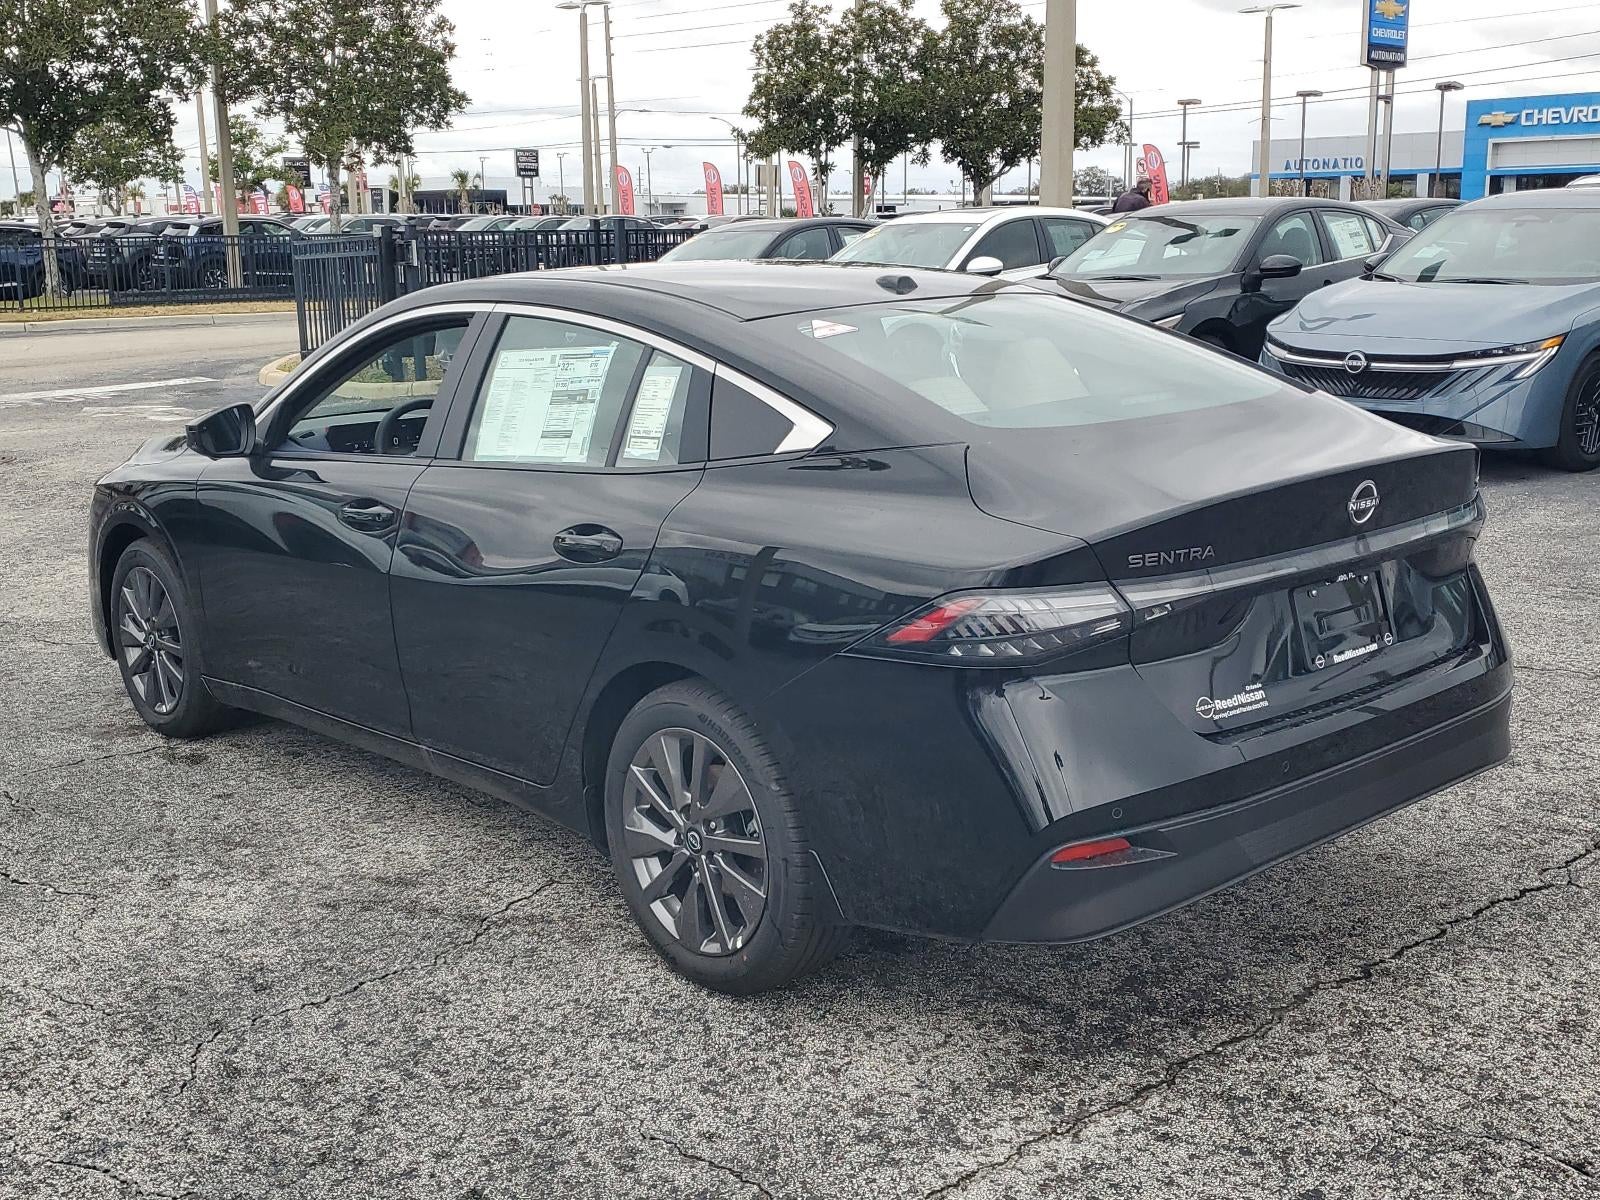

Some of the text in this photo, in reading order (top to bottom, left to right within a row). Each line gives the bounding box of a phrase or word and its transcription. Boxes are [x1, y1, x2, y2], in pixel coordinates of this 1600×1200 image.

[1372, 27, 1406, 40] CHEVROLET
[1371, 49, 1405, 62] AUTONATION
[1284, 157, 1364, 171] AUTONATIO
[1349, 497, 1380, 511] NISSAN
[1128, 545, 1215, 569] SENTRA
[1333, 643, 1378, 664] ReedNissan.com
[1195, 703, 1215, 712] NISSAN
